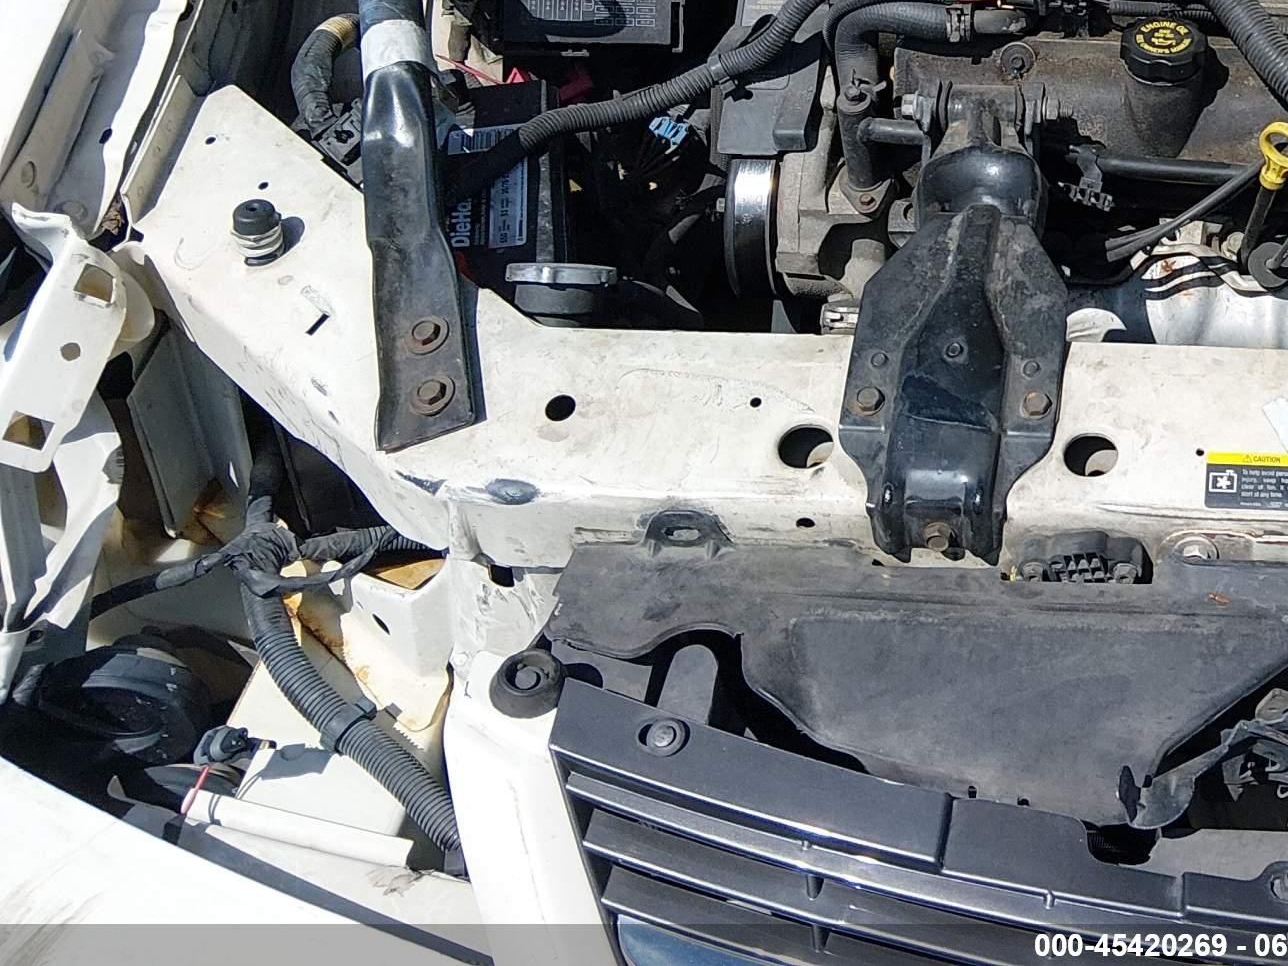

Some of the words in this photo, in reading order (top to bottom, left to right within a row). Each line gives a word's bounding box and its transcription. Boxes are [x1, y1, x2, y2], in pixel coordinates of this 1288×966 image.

[1140, 21, 1178, 33] ENGINE
[450, 199, 473, 248] DieHa
[1252, 455, 1281, 464] CAUTION
